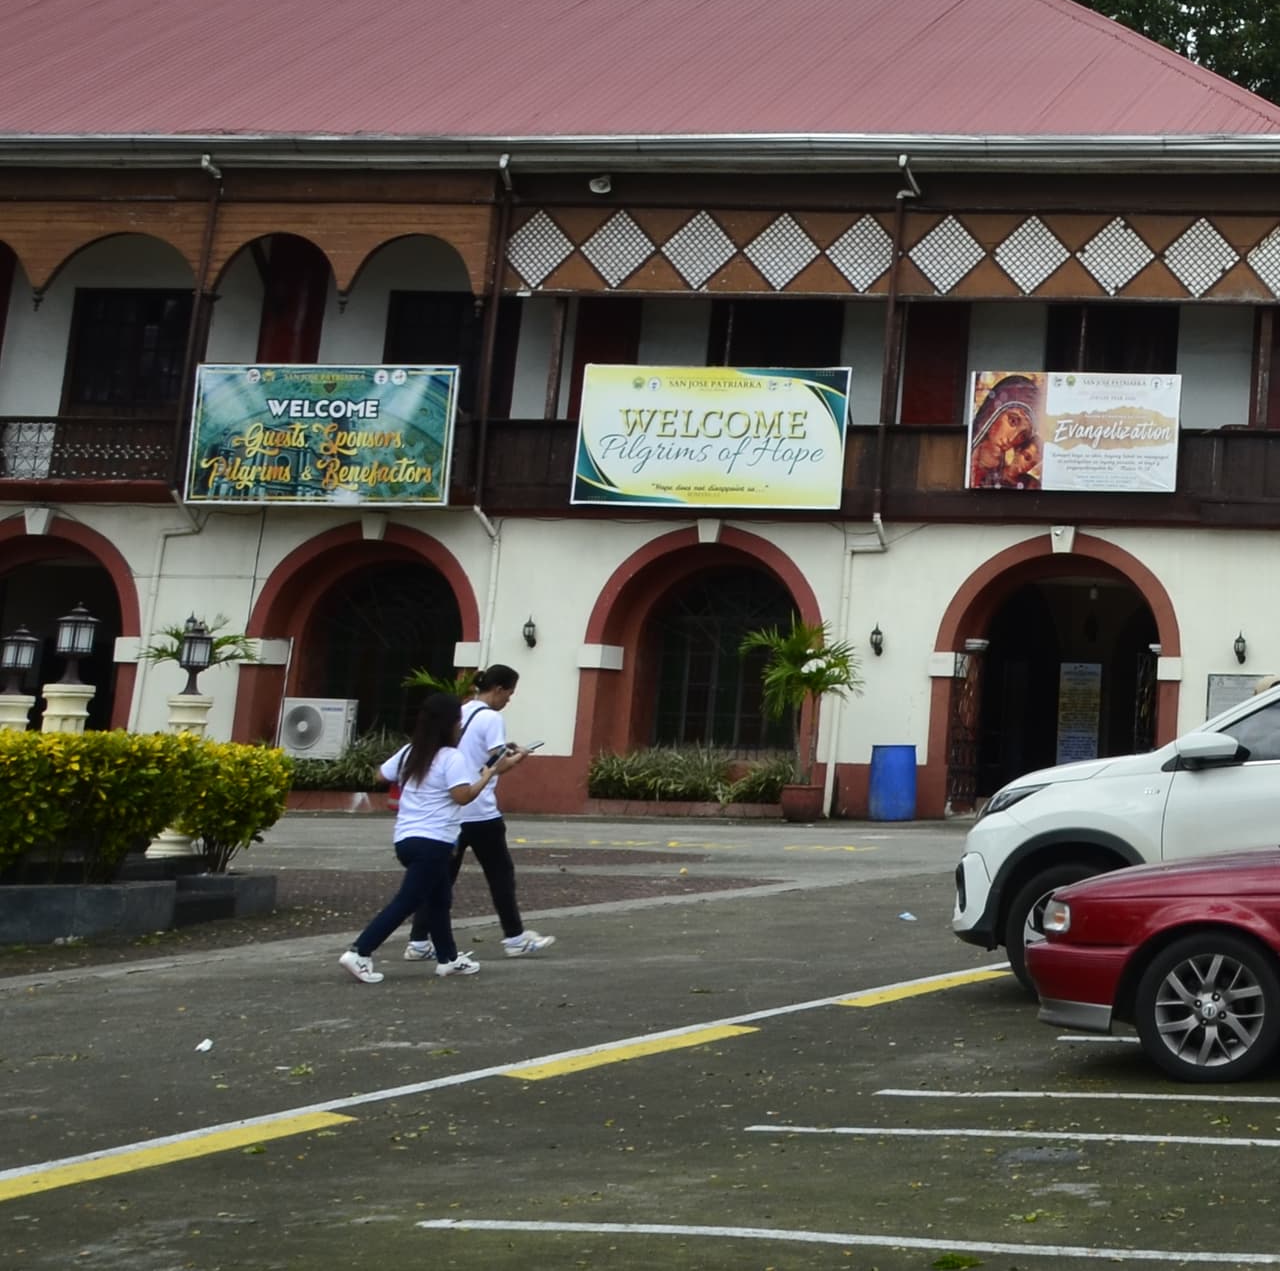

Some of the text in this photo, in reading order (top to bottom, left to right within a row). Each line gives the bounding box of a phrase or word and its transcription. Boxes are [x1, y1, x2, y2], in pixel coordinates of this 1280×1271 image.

[669, 380, 762, 389] SAN JOSE PATRIARKA
[267, 399, 379, 418] WELCOME
[619, 409, 808, 439] WELCOME
[1053, 419, 1171, 449] Evangelization
[599, 434, 824, 474] Pilgrims of Hope
[201, 456, 432, 491] Pilgrims & Benefactors
